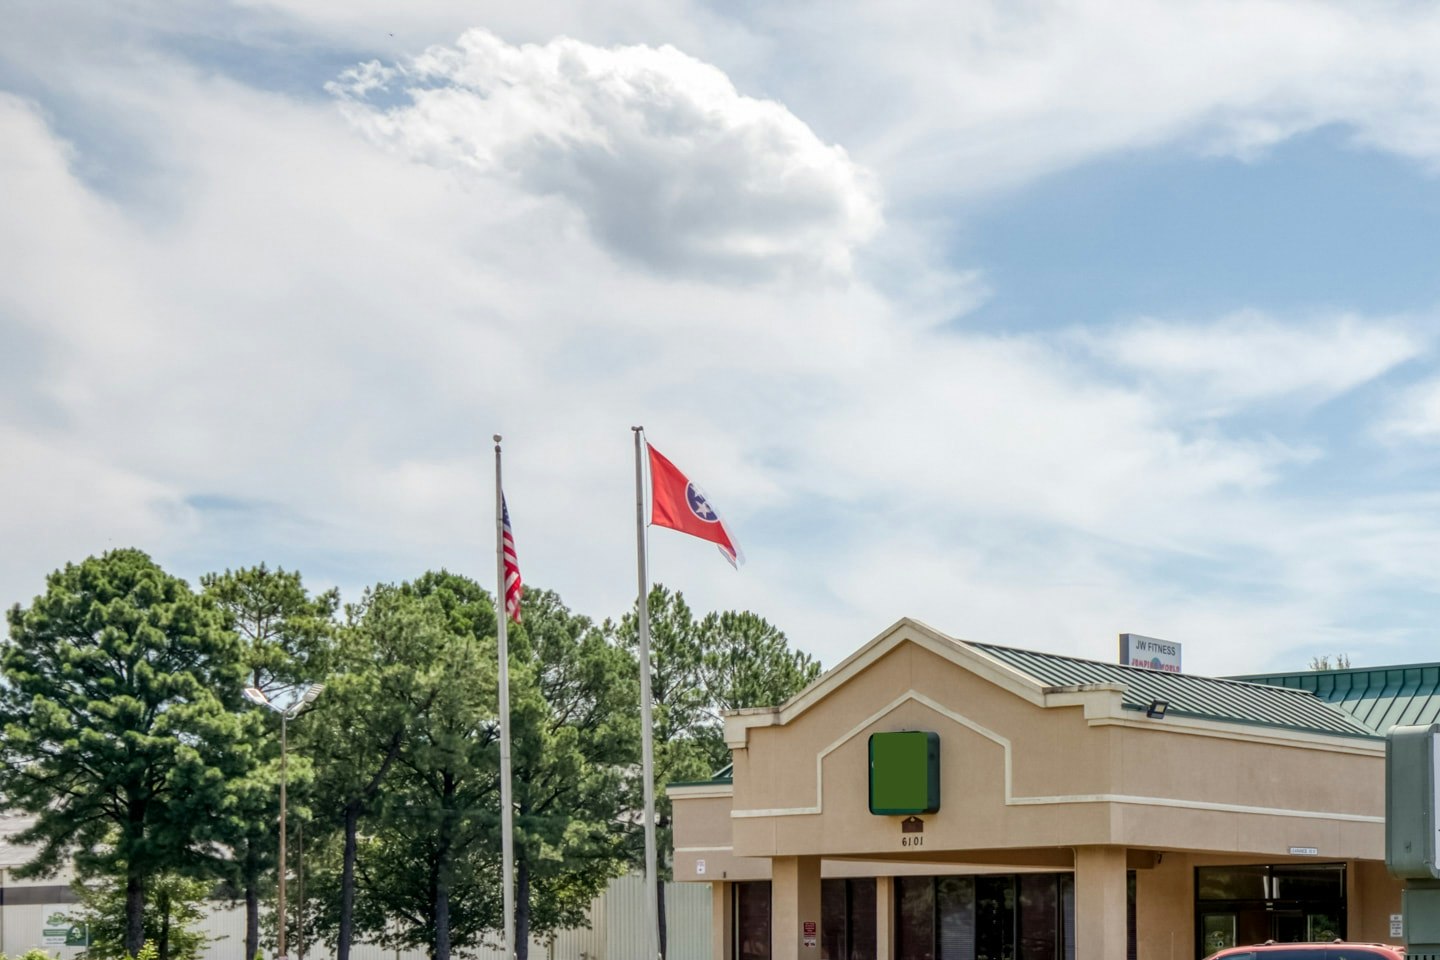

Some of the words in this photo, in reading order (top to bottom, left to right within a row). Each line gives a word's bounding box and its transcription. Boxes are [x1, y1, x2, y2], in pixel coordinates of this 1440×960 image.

[1136, 640, 1147, 651] JW
[1148, 642, 1176, 656] FITNESS
[902, 836, 923, 847] 6101
